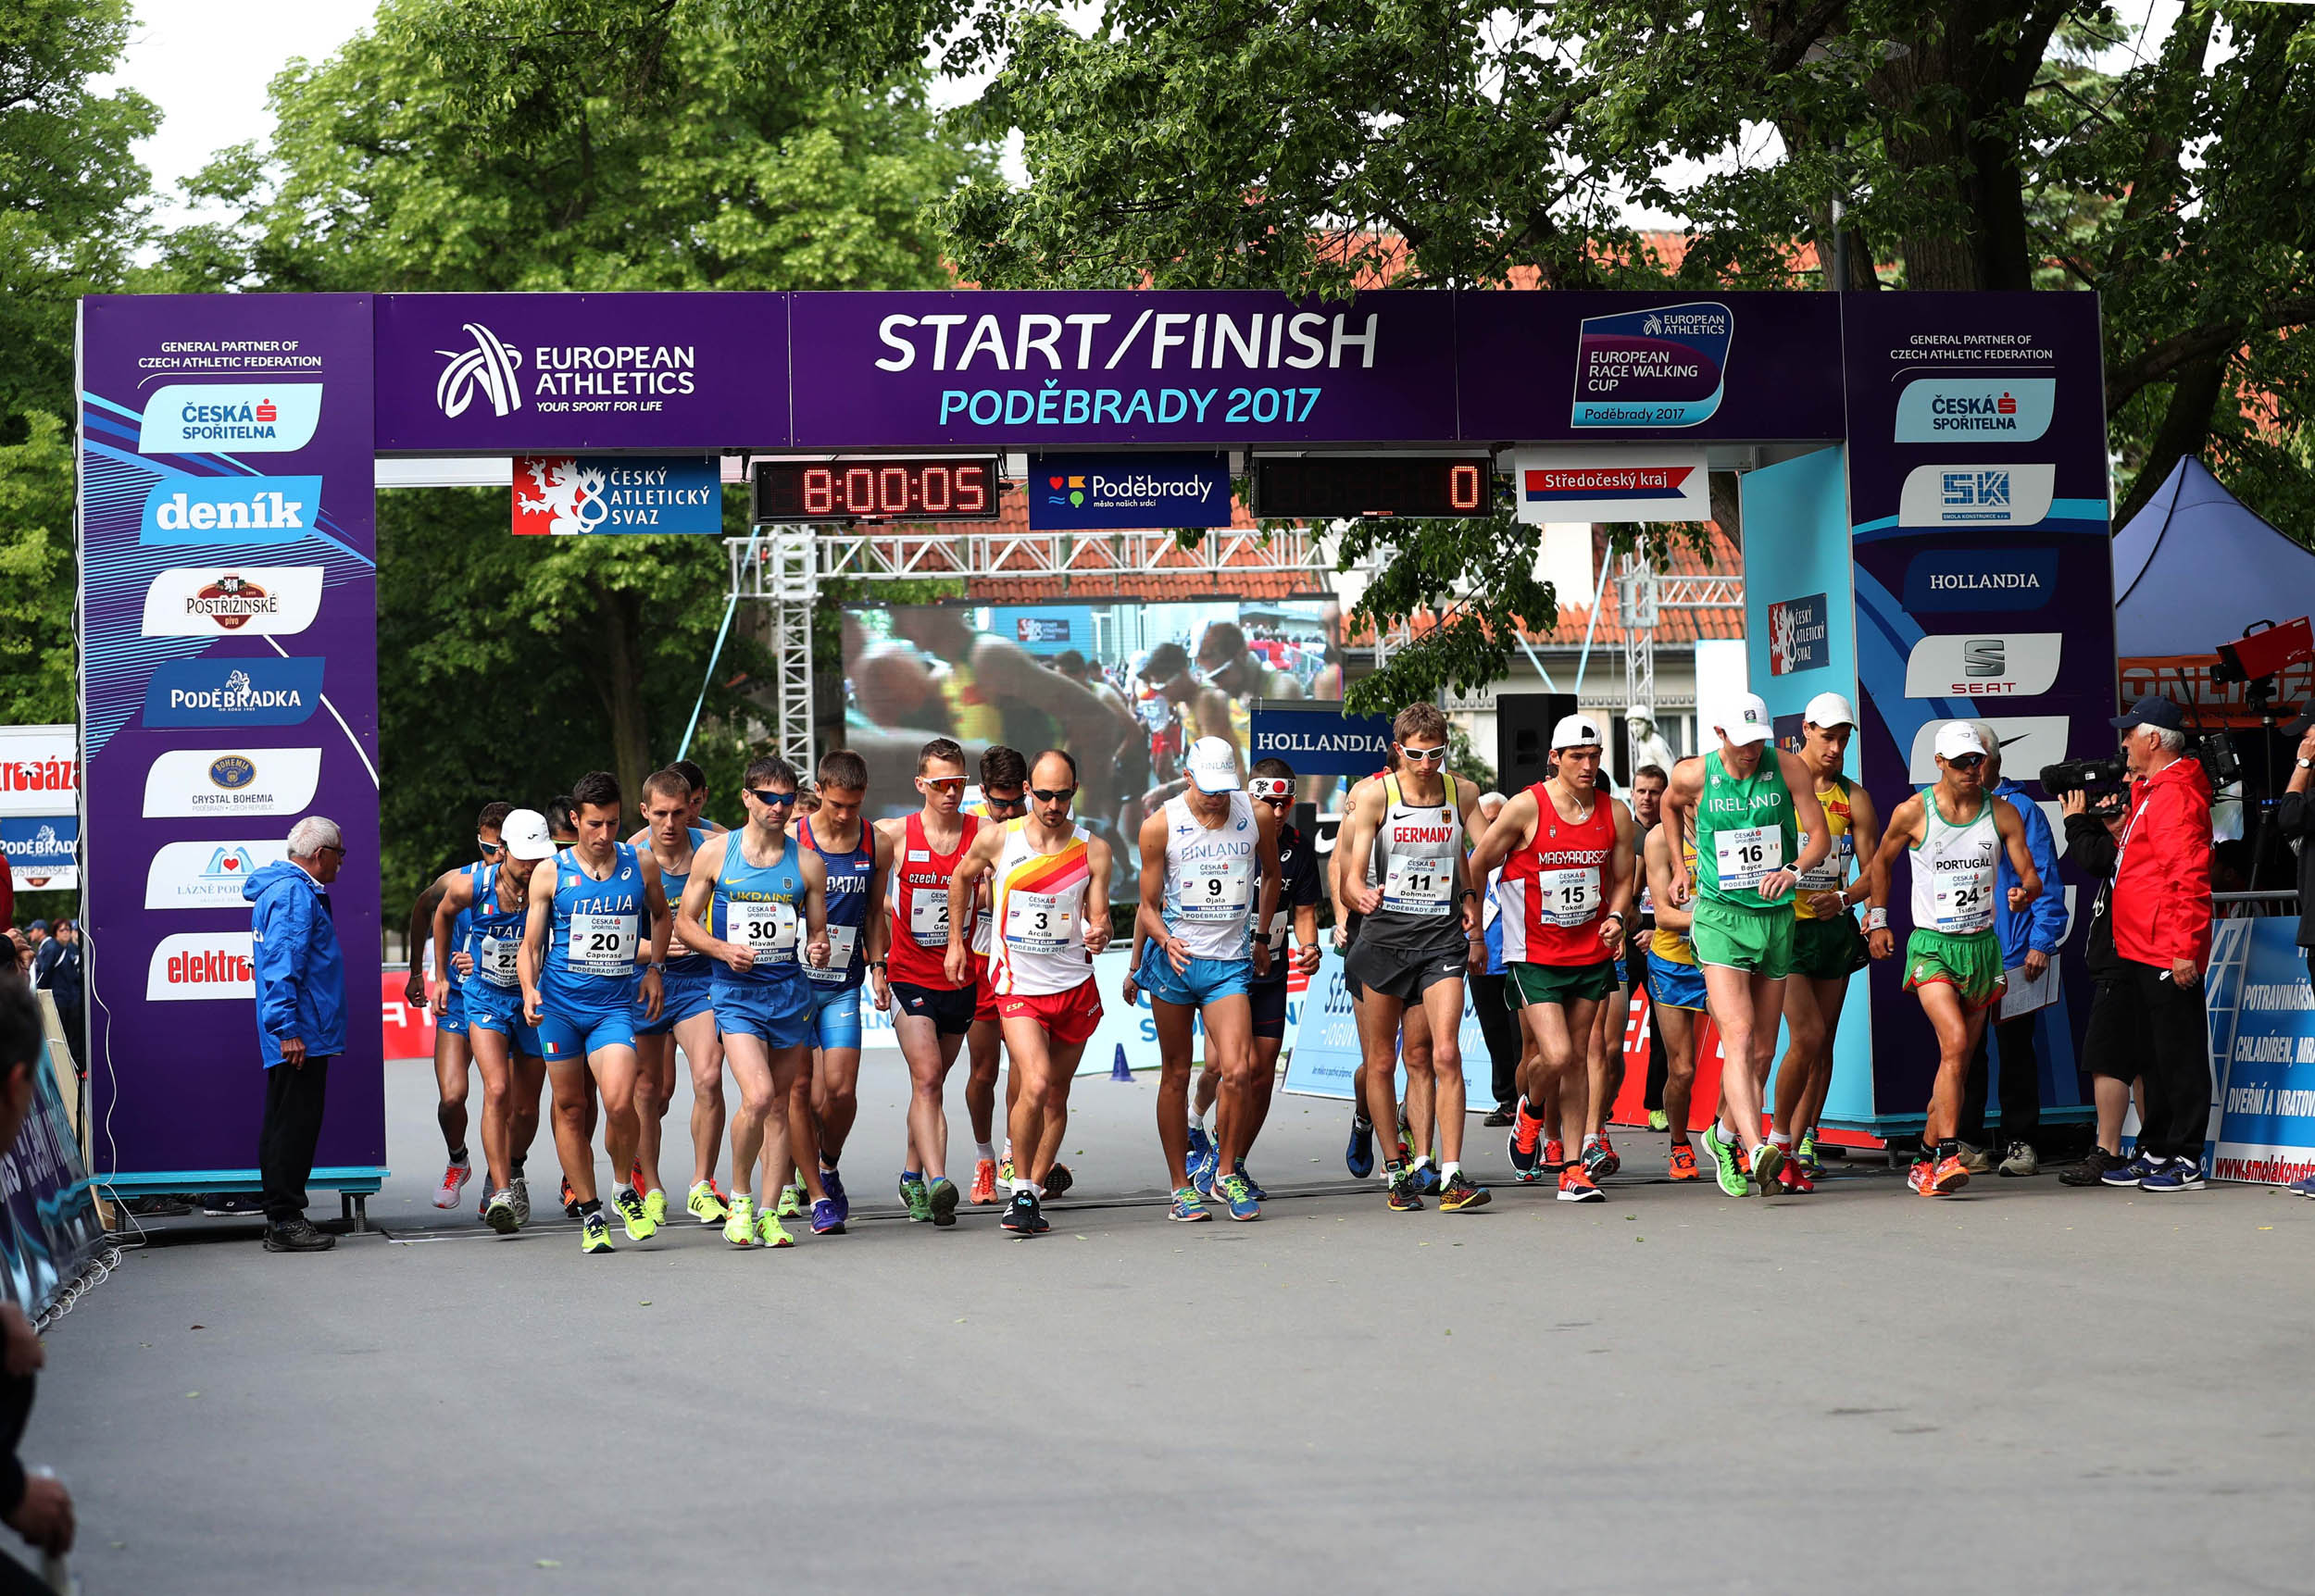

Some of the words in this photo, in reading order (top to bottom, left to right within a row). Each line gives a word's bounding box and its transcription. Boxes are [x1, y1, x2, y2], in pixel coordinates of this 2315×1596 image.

[1664, 315, 1724, 324] EUROPEAN
[1664, 325, 1724, 334] ATHLETICS
[161, 342, 219, 352] GENERAL
[221, 341, 280, 352] PARTNER
[282, 341, 298, 351] OF
[874, 309, 1378, 371] START/FINISH
[1910, 335, 1961, 344] GENERAL
[1964, 335, 2016, 344] PARTNER
[2017, 335, 2032, 344] OF
[138, 357, 180, 368] CZECH
[182, 356, 241, 368] ATHLETIC
[244, 355, 321, 367] FEDERATION
[536, 346, 694, 369] EUROPEAN
[1591, 352, 1670, 363] EUROPEAN
[1890, 350, 1927, 359] CZECH
[1930, 350, 1982, 359] ATHLETIC
[1984, 350, 2053, 359] FEDERATION
[1589, 366, 1629, 377] RACE
[1633, 366, 1698, 377] WALKING
[535, 372, 694, 395] ATHLETICS
[1588, 380, 1619, 392] CUP
[536, 402, 569, 412] YOUR
[572, 402, 611, 412] SPORT
[614, 401, 637, 411] FOR
[640, 401, 663, 411] LIFE
[939, 377, 1219, 426] PODĚBRADY
[1224, 387, 1321, 424] 2017
[1932, 394, 1996, 415] ČESKÁ
[181, 401, 254, 423] ČESKÁ
[1585, 408, 1653, 423] Poděbrady
[1657, 408, 1684, 420] 2017
[182, 424, 276, 439] SPOŘITELNA
[1933, 416, 2017, 430] SPOŘITELNA
[611, 467, 667, 485] ČESKÝ
[1545, 472, 1637, 489] Středočeský
[1640, 471, 1667, 489] kraj
[610, 486, 710, 505] ATLETICKÝ
[804, 467, 983, 512] 8:00:05
[1093, 474, 1213, 503] Poděbrady
[1451, 466, 1478, 508] 0
[156, 492, 303, 530] deník
[1094, 499, 1114, 507] město
[1116, 499, 1138, 507] našich
[1140, 499, 1157, 507] srdcí
[612, 509, 659, 525] SVAZ
[1930, 574, 2040, 589] HOLLANDIA
[187, 593, 277, 614] POSTŘIŽINSKÉ
[225, 616, 239, 626] pivo
[1795, 605, 1812, 626] ČESKÝ
[1796, 620, 1825, 643] ATLETICKÝ
[1796, 645, 1811, 662] SVAZ
[1951, 682, 2016, 694] SEAT
[170, 688, 301, 708] PODĚBRADKA
[1258, 733, 1387, 753] HOLLANDIA
[215, 758, 249, 771] BOHEMIA
[192, 794, 231, 804] CRYSTAL
[233, 793, 274, 804] BOHEMIA
[1709, 792, 1781, 813] IRELAND
[1394, 827, 1453, 842] GERMANY
[1182, 842, 1251, 859] FINLAND
[1738, 845, 1763, 863] 16
[1936, 858, 1992, 870] PORTUGAL
[909, 871, 936, 884] czech
[1408, 875, 1431, 890] 11
[177, 883, 215, 895] LÁZNĚ
[1208, 879, 1221, 896] 9
[1561, 886, 1584, 904] 15
[572, 894, 632, 915] ITALIA
[730, 891, 793, 904] UKRAINE
[1955, 888, 1979, 906] 24
[1035, 913, 1047, 929] 3
[488, 926, 524, 939] ITAL
[748, 921, 776, 939] 30
[591, 933, 619, 951] 20
[1007, 1002, 1024, 1013] ESP
[2235, 1029, 2294, 1067] CHLADÍREN,
[2227, 1081, 2267, 1115] DVEŘNÍ
[2266, 1091, 2274, 1115] A
